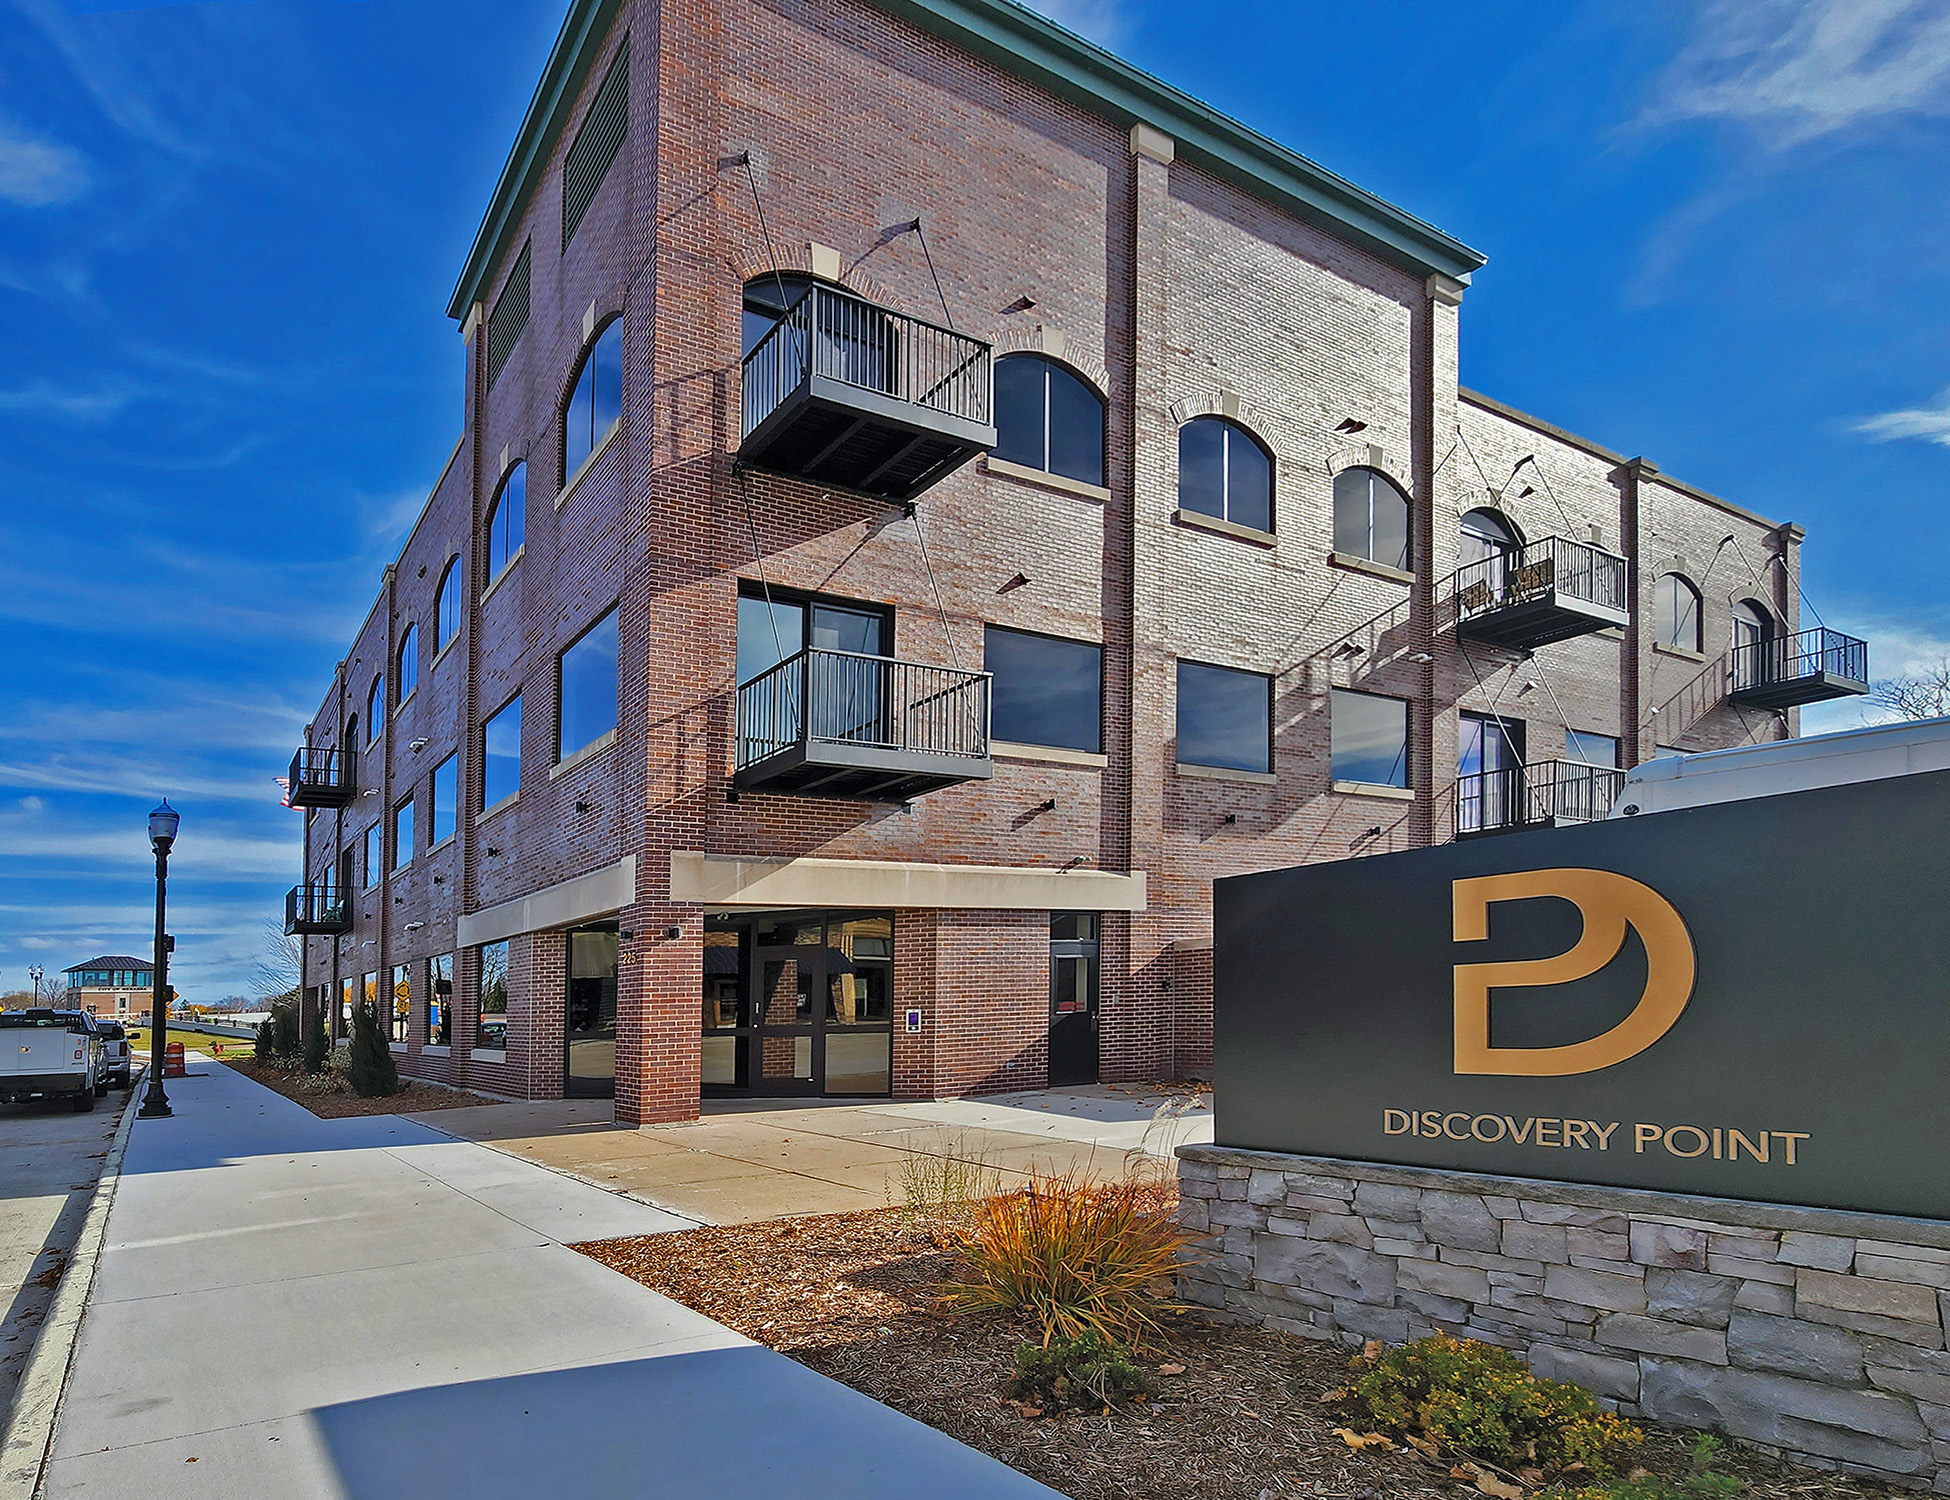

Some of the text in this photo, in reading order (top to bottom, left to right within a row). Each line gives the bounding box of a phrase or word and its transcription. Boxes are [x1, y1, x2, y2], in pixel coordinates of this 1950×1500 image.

[622, 951, 636, 965] 225
[1383, 1108, 1811, 1165] DISCOVERY POINT
